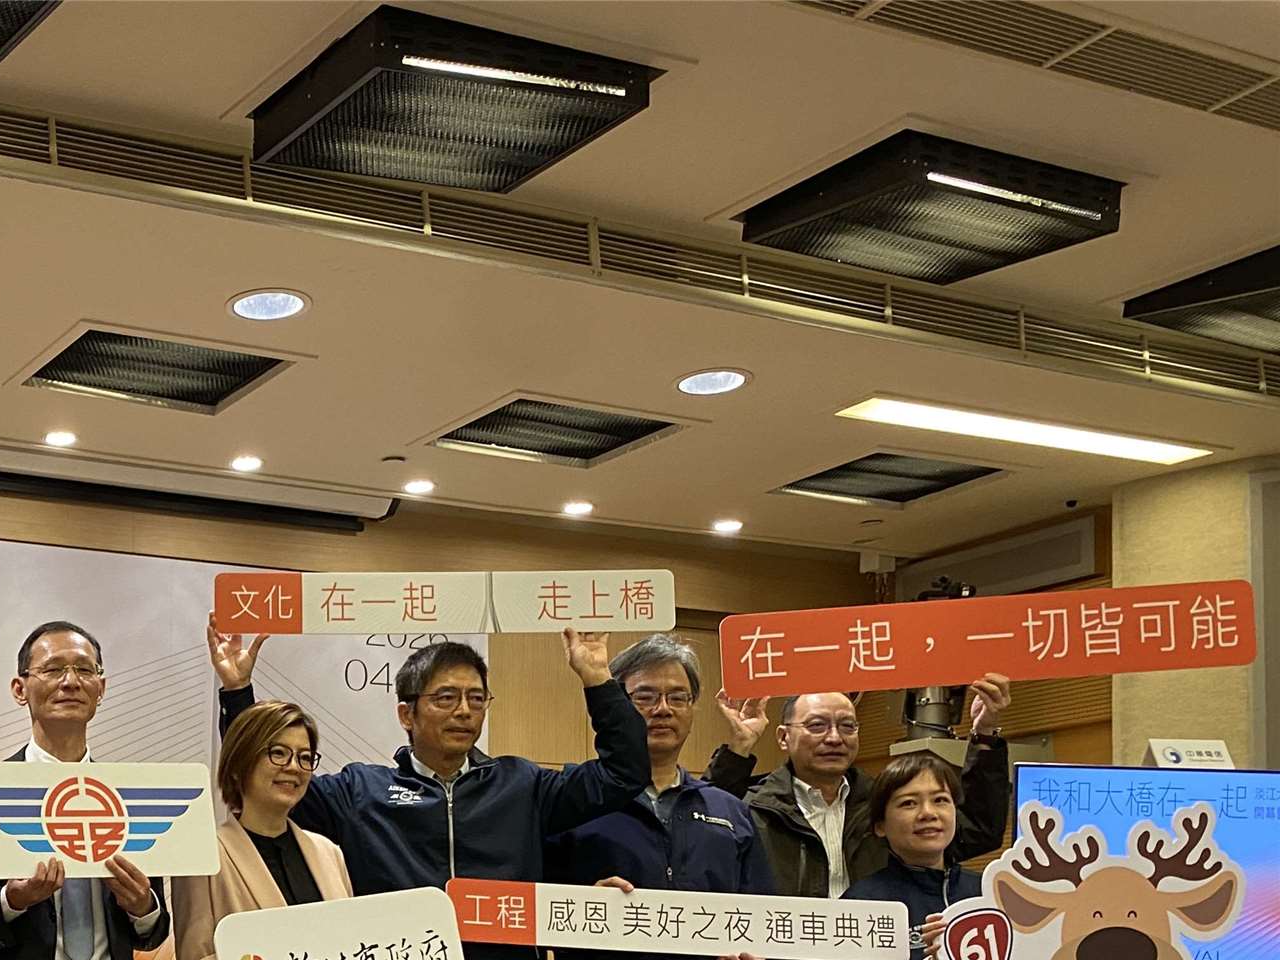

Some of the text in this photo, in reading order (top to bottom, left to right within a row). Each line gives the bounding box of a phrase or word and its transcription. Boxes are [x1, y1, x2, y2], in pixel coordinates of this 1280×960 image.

[230, 578, 656, 623] 文化 在一起 走上橋
[739, 593, 1240, 681] 在一起，一切皆可能
[344, 658, 393, 693] 04
[1031, 776, 1249, 820] 我和大橋在一起
[462, 893, 898, 950] 工程 感恩 美好之夜 通車典禮
